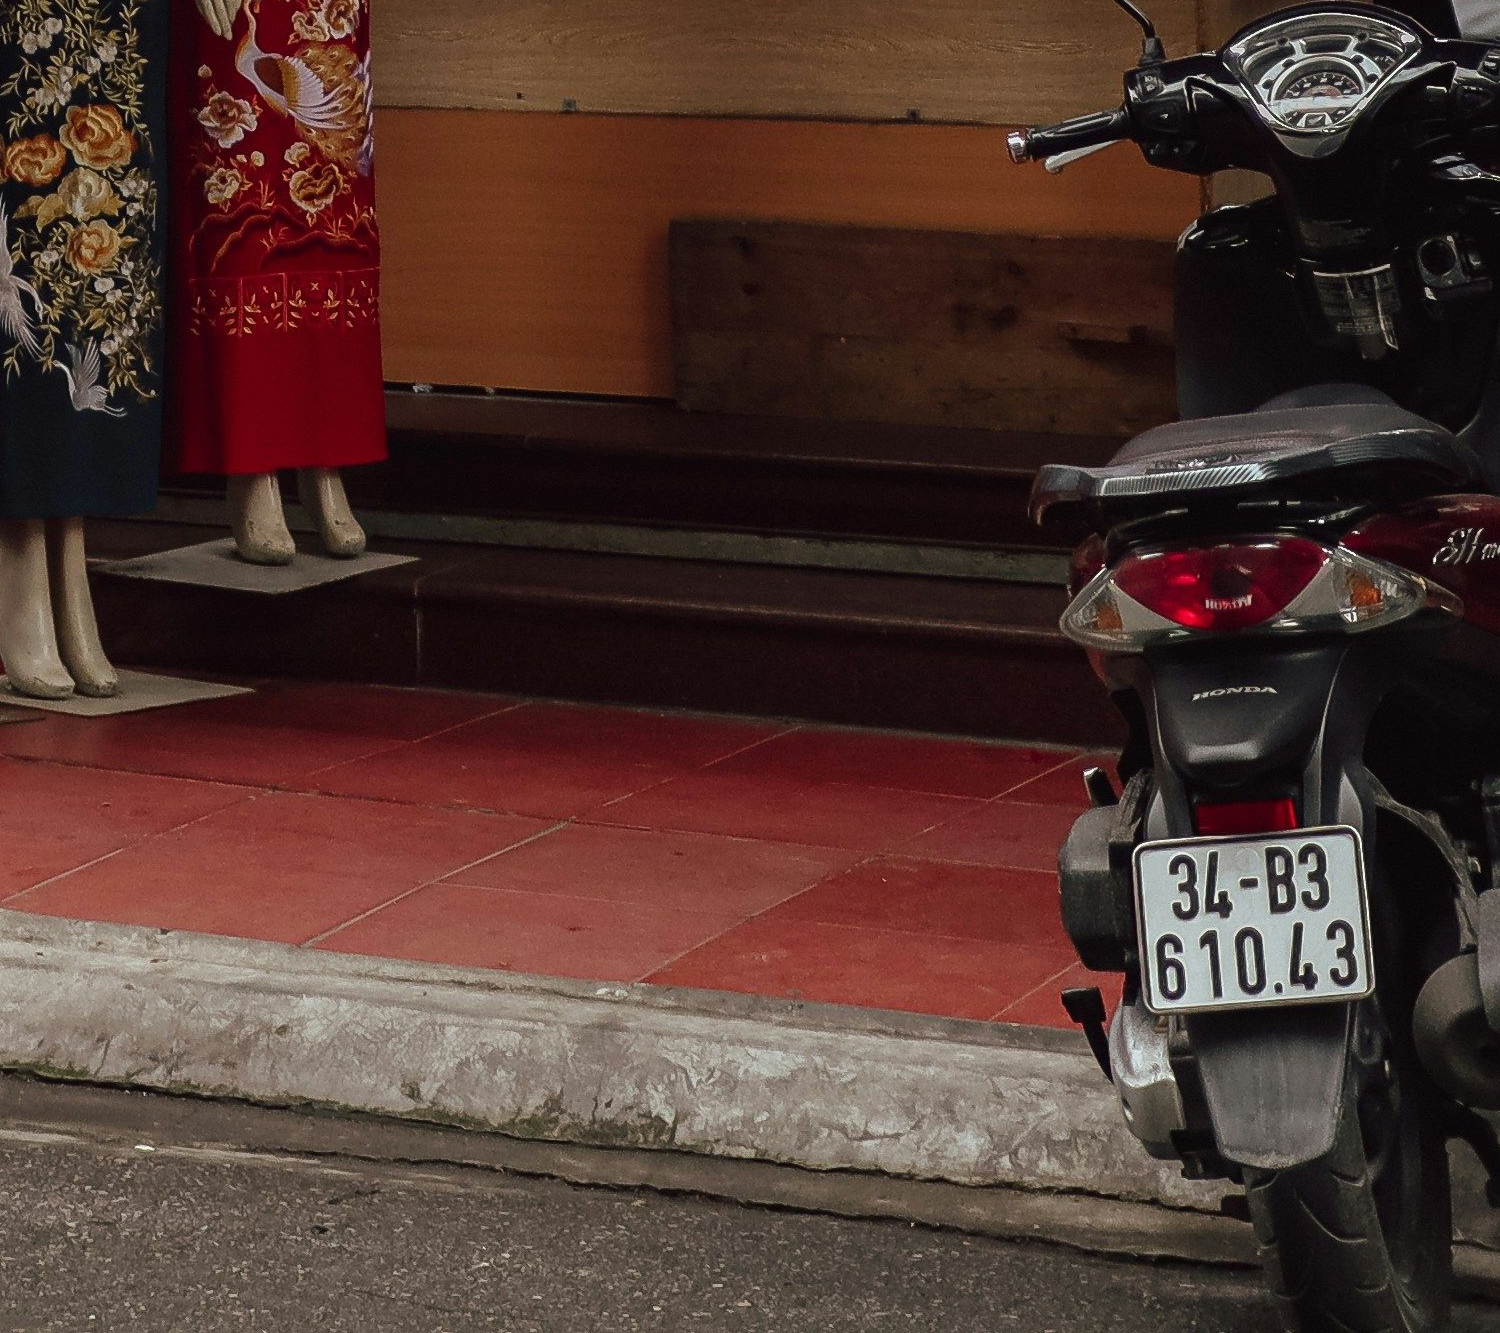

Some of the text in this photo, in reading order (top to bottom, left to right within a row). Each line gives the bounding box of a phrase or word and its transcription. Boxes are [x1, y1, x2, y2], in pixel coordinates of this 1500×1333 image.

[1191, 686, 1278, 702] HONDA
[1168, 842, 1331, 921] 34-B3
[1155, 919, 1359, 1001] 610.43
